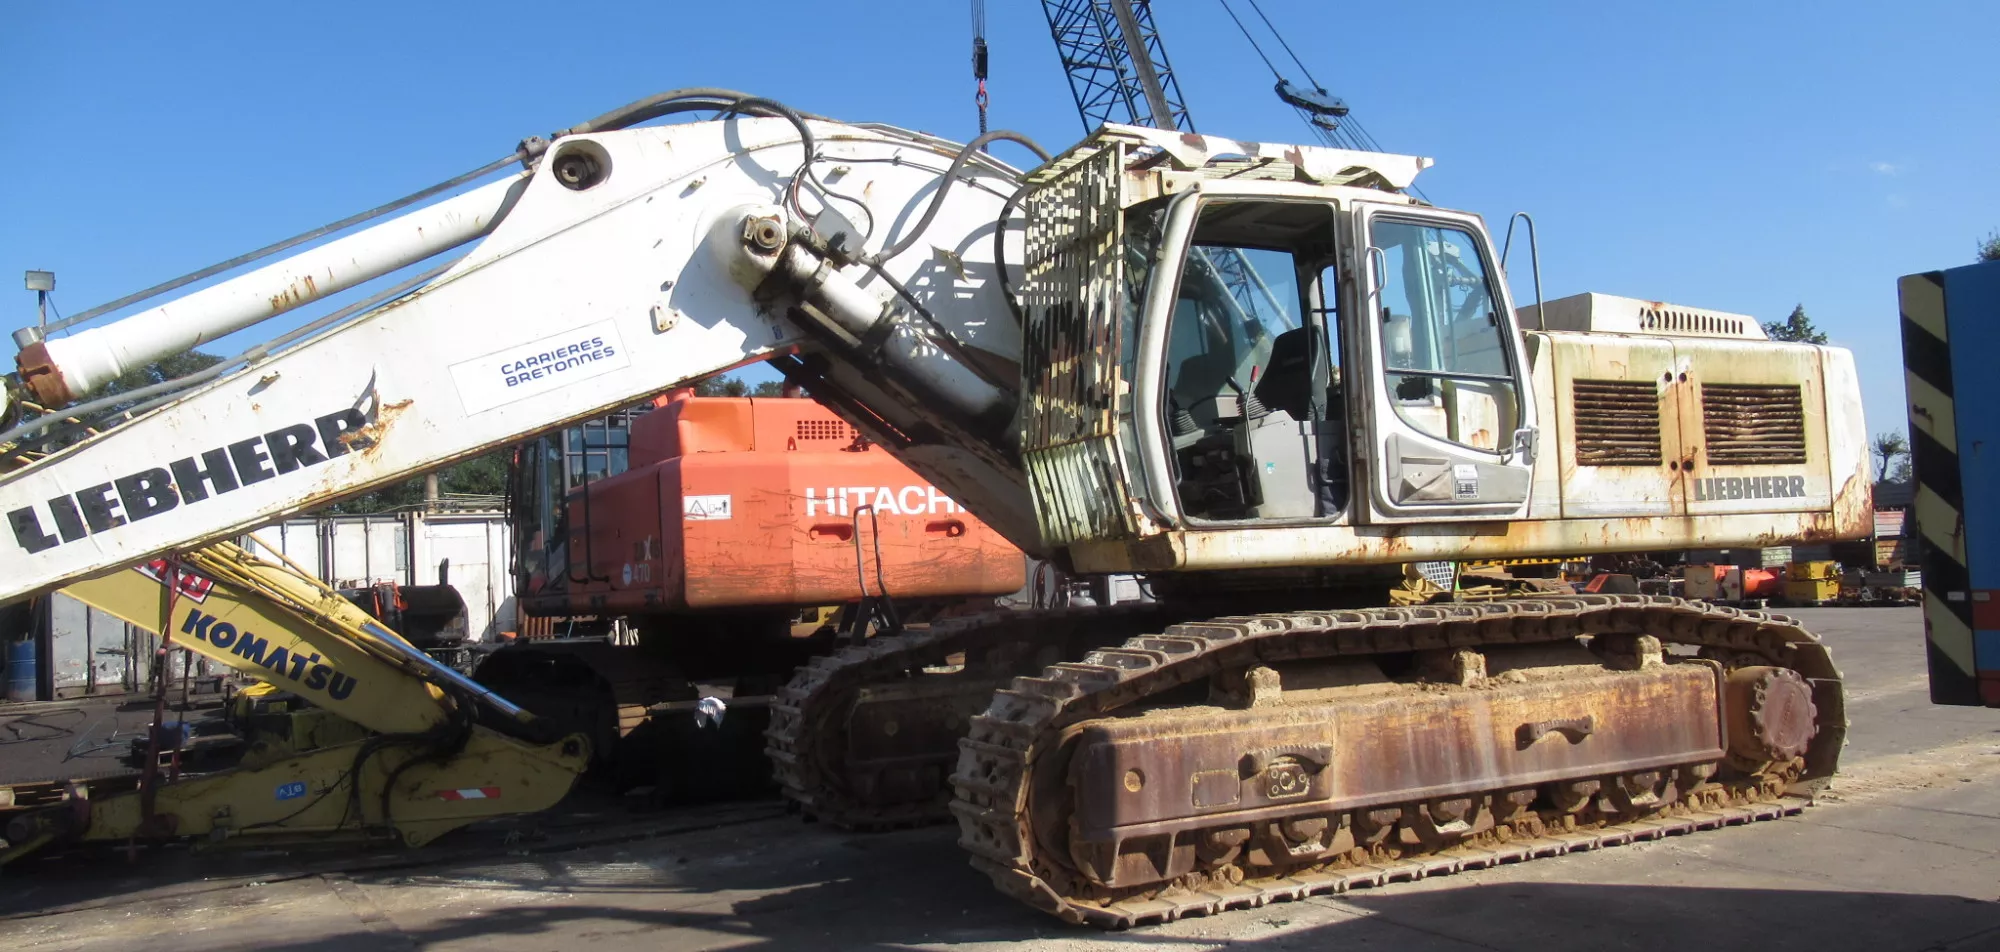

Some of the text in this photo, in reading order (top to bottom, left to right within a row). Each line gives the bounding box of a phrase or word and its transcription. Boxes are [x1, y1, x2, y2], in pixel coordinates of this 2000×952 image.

[501, 337, 603, 375] CARRIERES
[505, 346, 615, 387] BRETONNES
[806, 486, 965, 516] HITACH
[1695, 475, 1806, 501] LIEBHERR
[181, 608, 357, 699] KOMATSU
